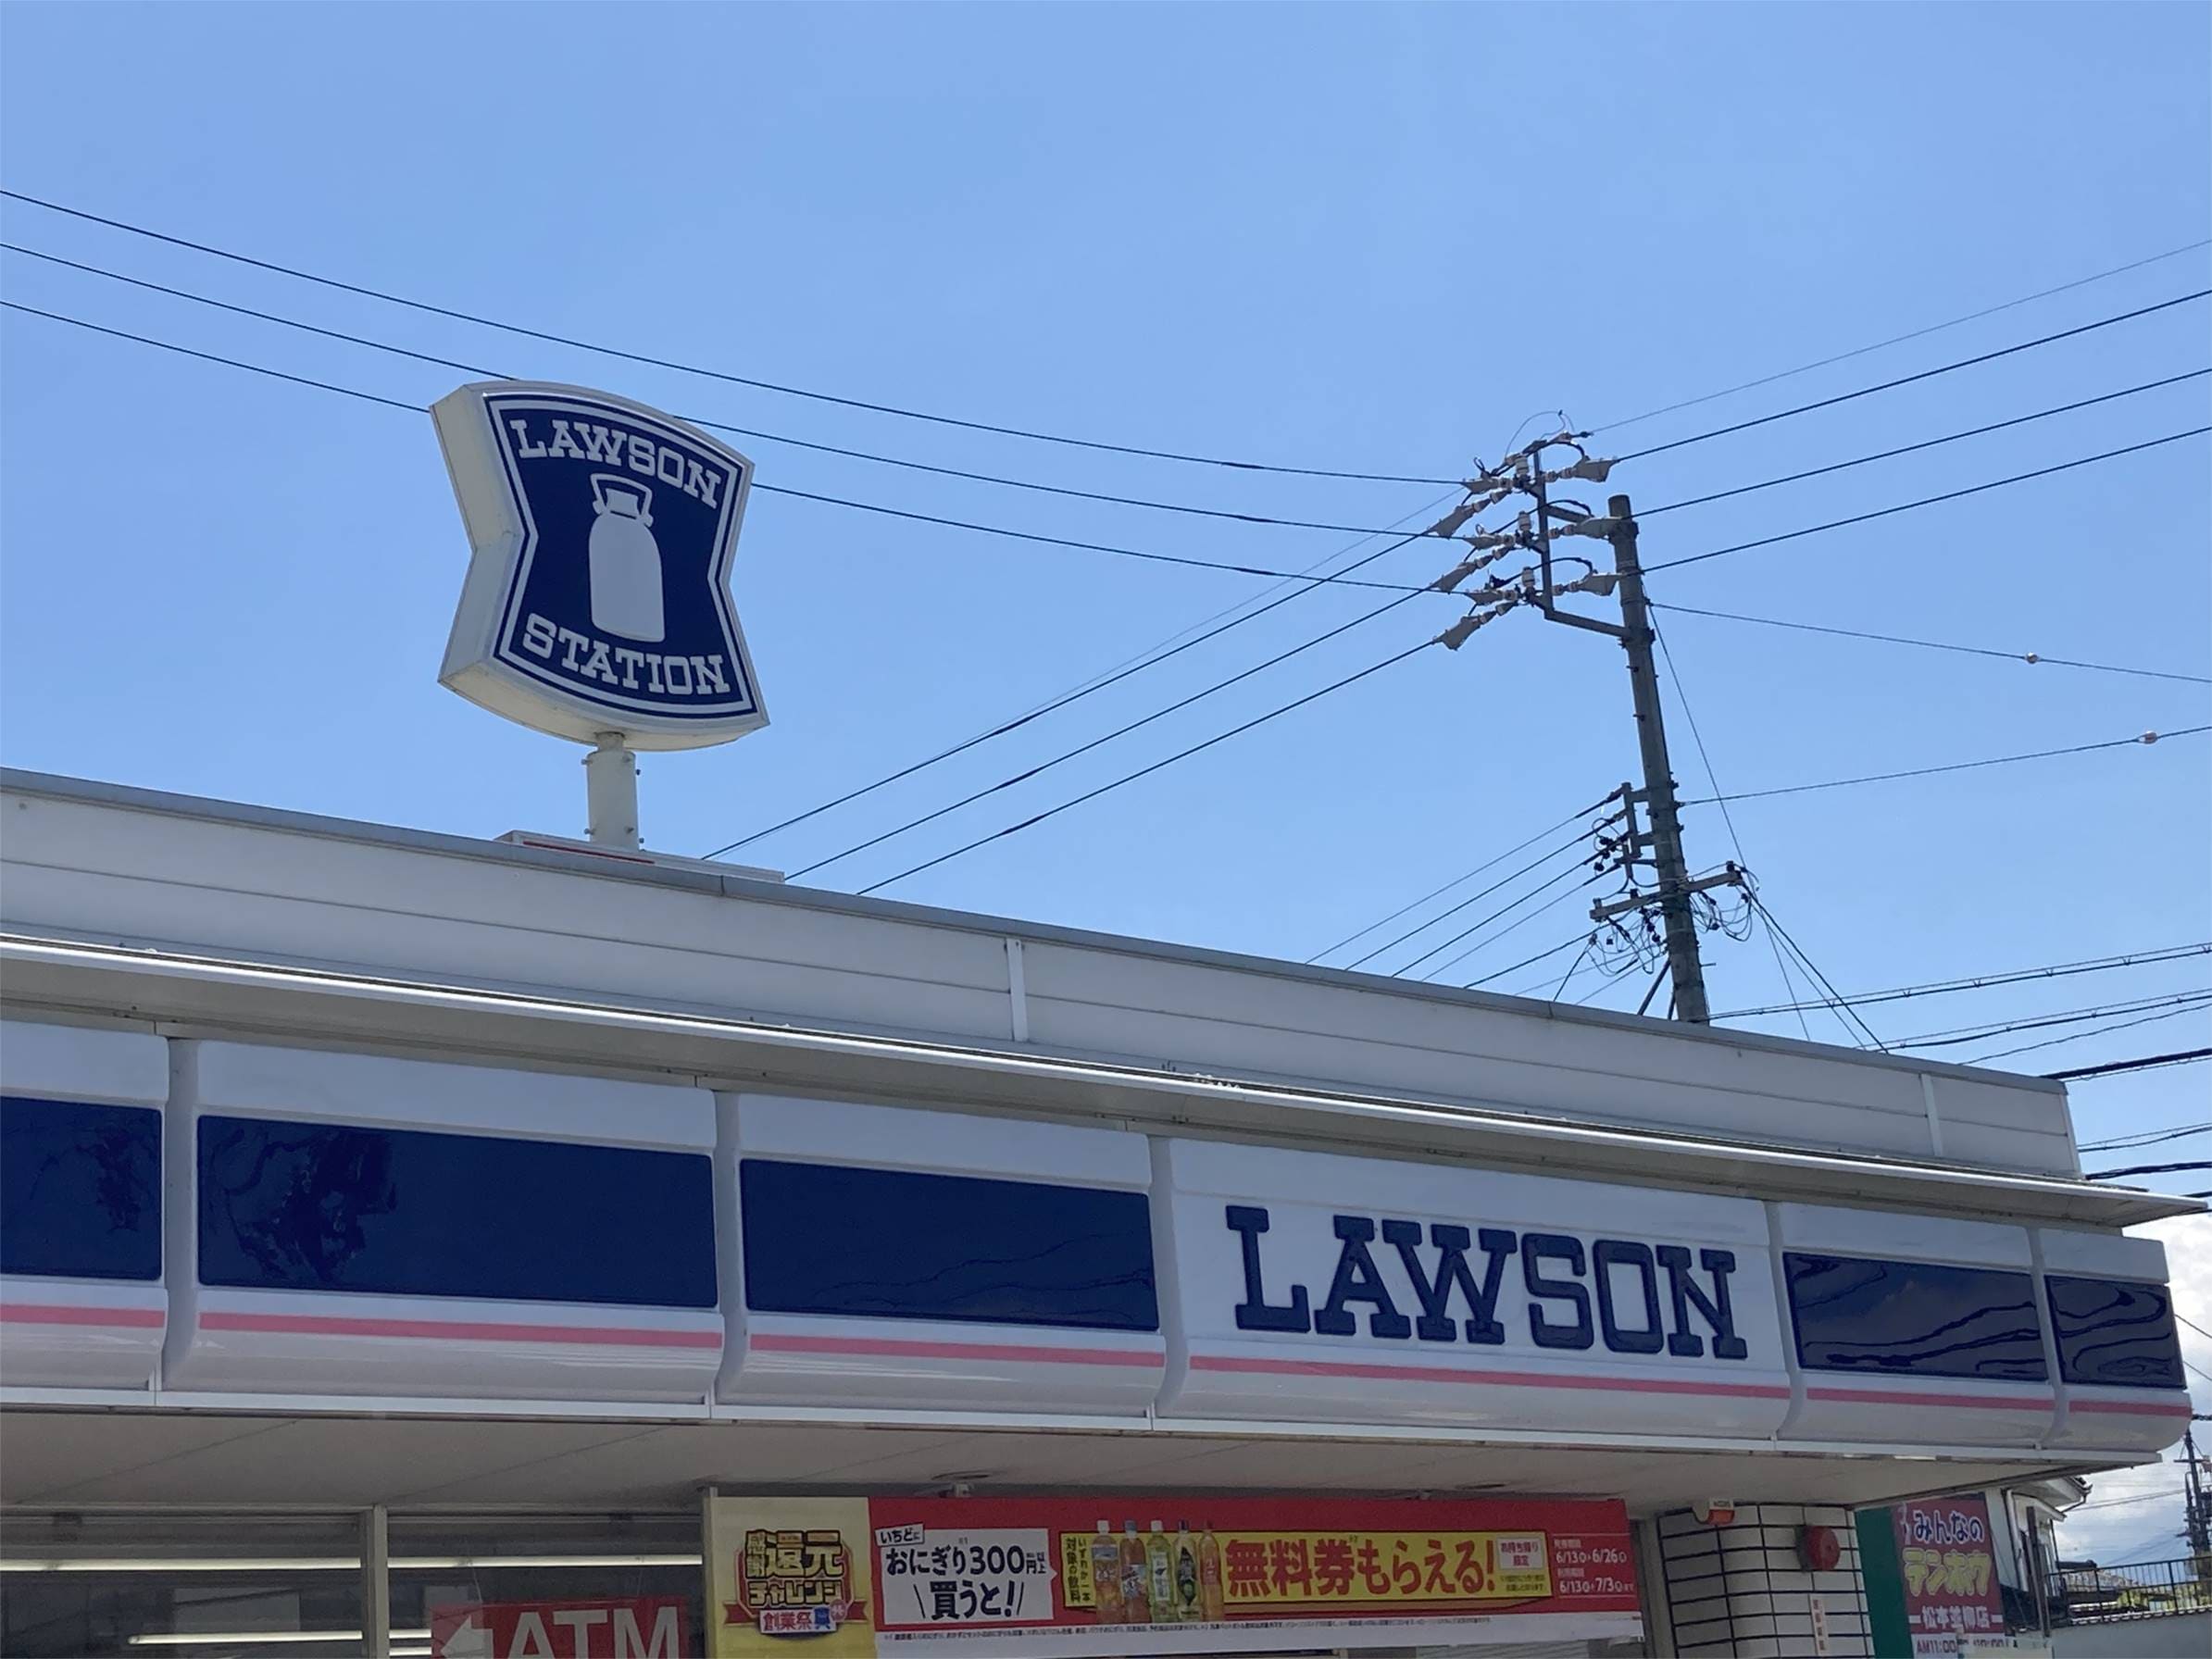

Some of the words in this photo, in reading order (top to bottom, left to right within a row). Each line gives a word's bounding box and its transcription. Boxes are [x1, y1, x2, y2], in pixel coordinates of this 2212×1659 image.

[510, 419, 722, 509] LAWSON
[522, 613, 731, 695] STATION
[1225, 1204, 1748, 1360] LAWSON
[881, 1528, 920, 1543] いちどに
[1913, 1510, 1985, 1544] みんなの
[748, 1580, 844, 1606] チャレンジ
[1902, 1547, 1993, 1597] テンホウ
[509, 1606, 680, 1659] ATM
